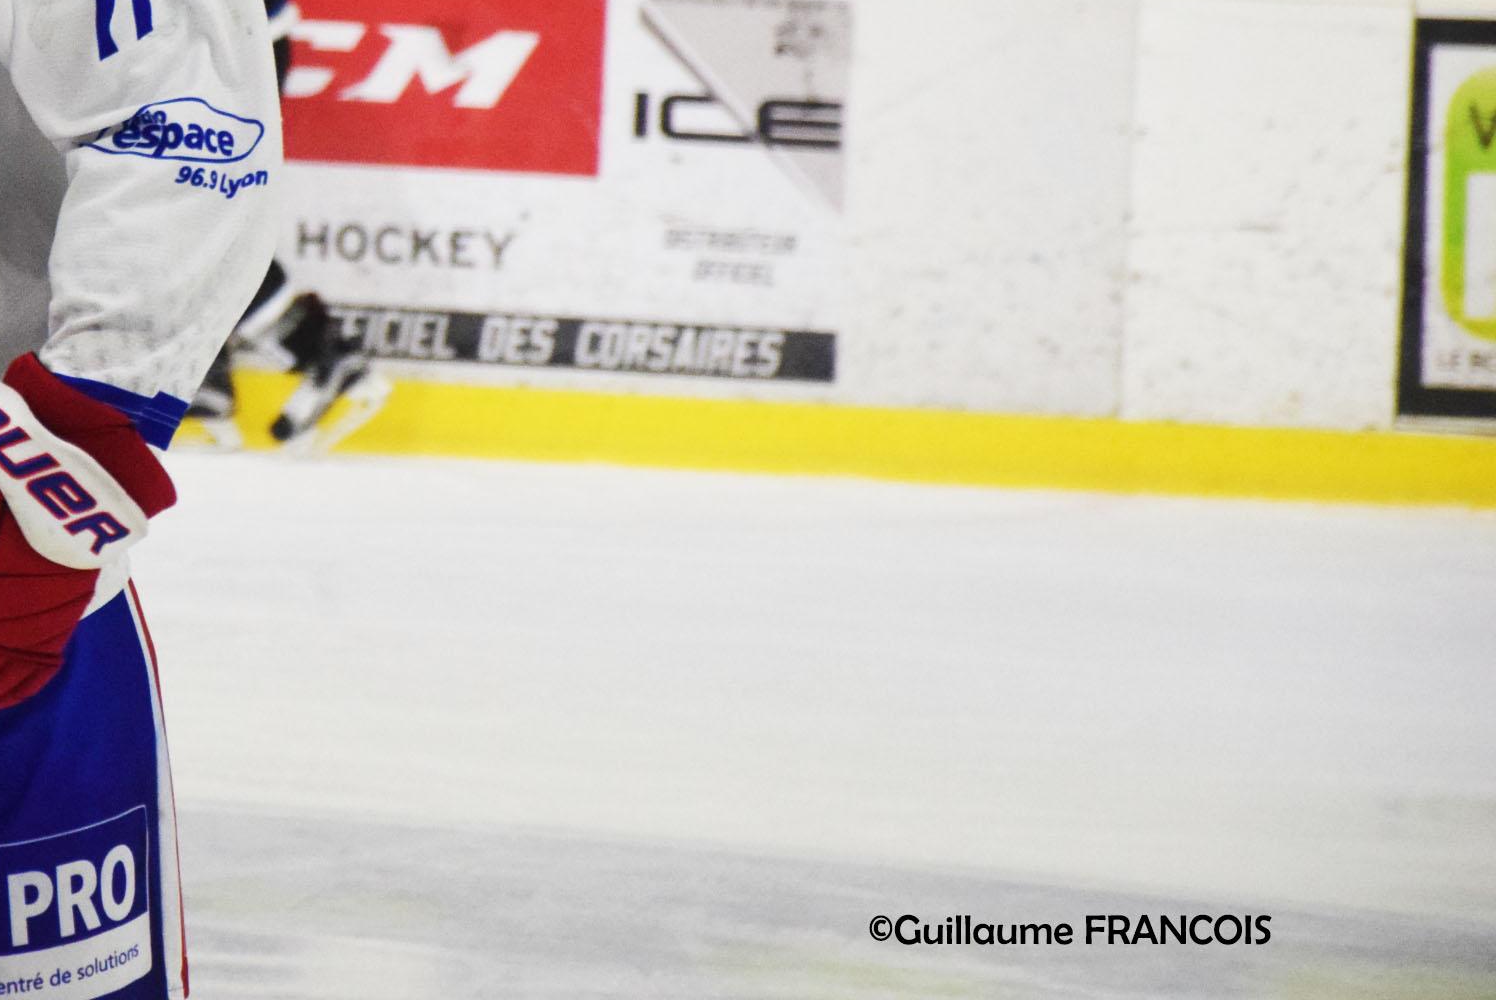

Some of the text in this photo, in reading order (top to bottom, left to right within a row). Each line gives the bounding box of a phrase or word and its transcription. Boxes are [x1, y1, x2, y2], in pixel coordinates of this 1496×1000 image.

[112, 122, 235, 158] espace
[634, 91, 843, 148] ICE
[219, 170, 269, 199] Lyon
[296, 221, 517, 268] HOCKEY
[330, 309, 784, 377] FICIEL DES CORSAIRES
[50, 967, 72, 986] de
[77, 943, 140, 980] solutions
